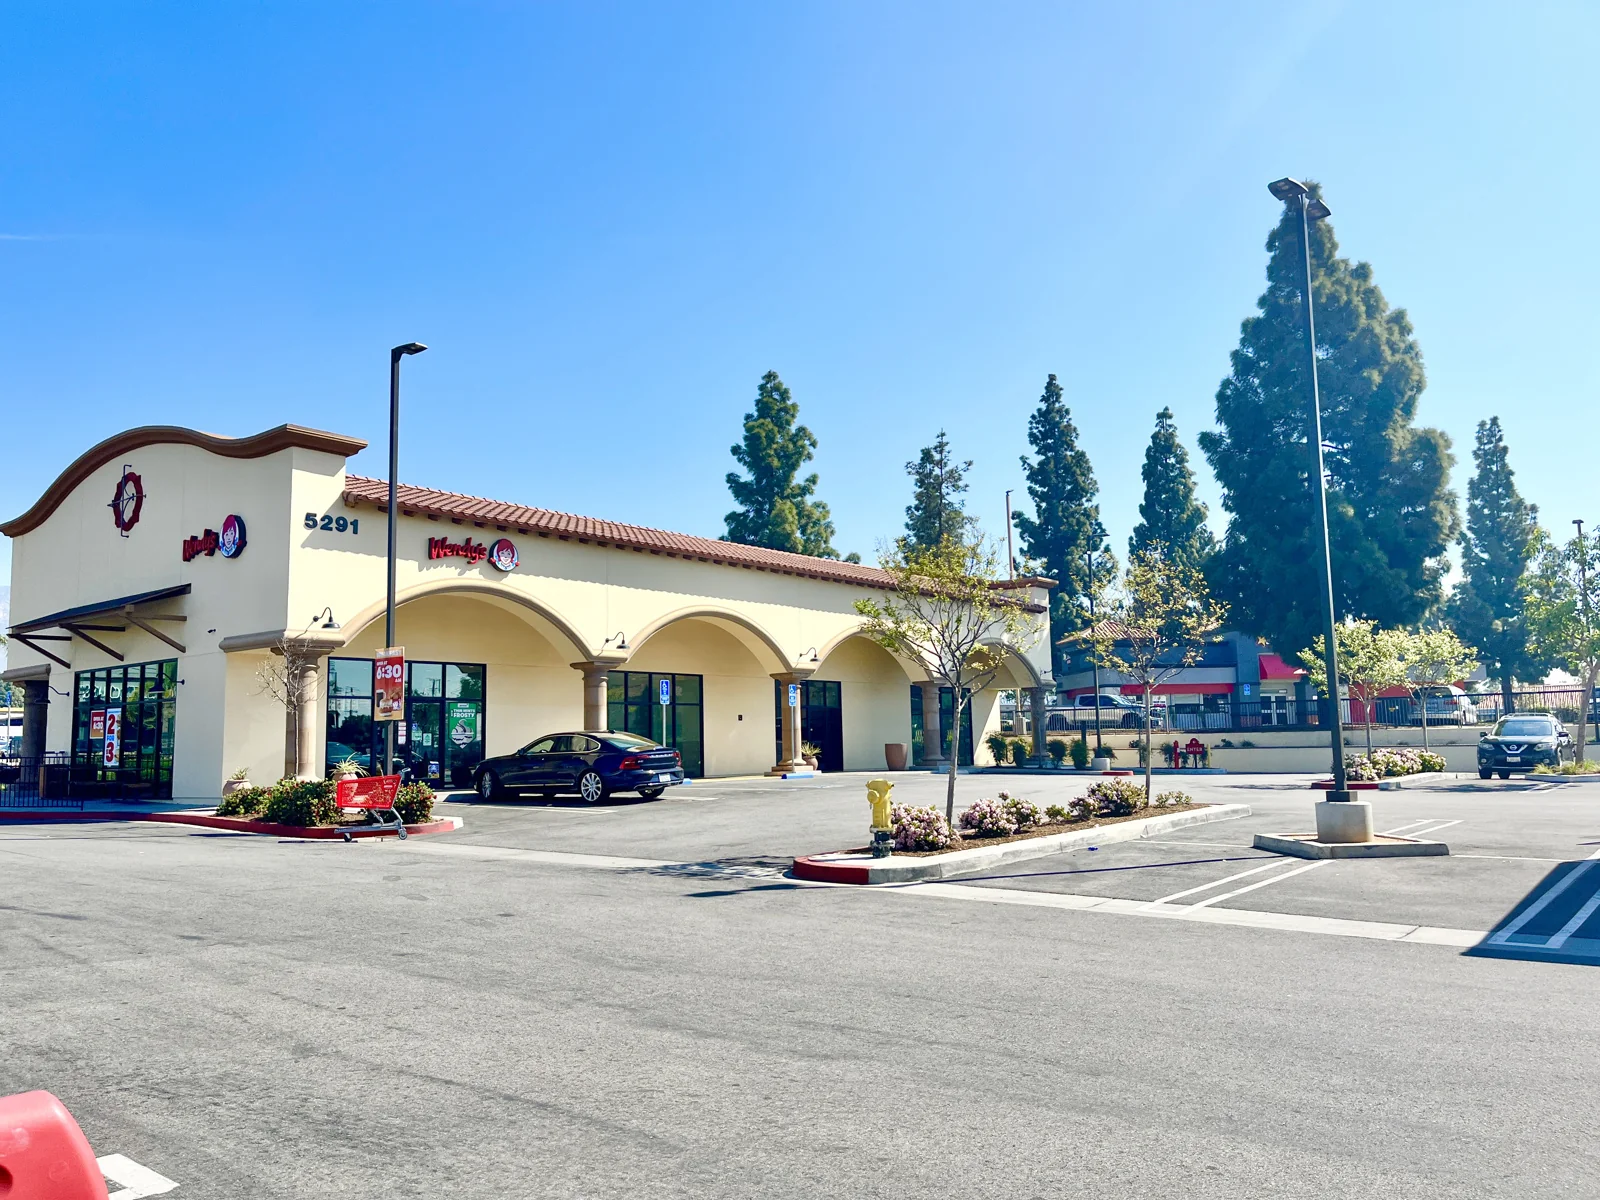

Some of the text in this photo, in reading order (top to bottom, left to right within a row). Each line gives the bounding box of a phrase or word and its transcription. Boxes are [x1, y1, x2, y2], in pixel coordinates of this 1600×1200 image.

[304, 512, 359, 534] 5291
[428, 537, 487, 564] Wendy's
[376, 664, 402, 679] 6:30
[108, 714, 116, 734] 2
